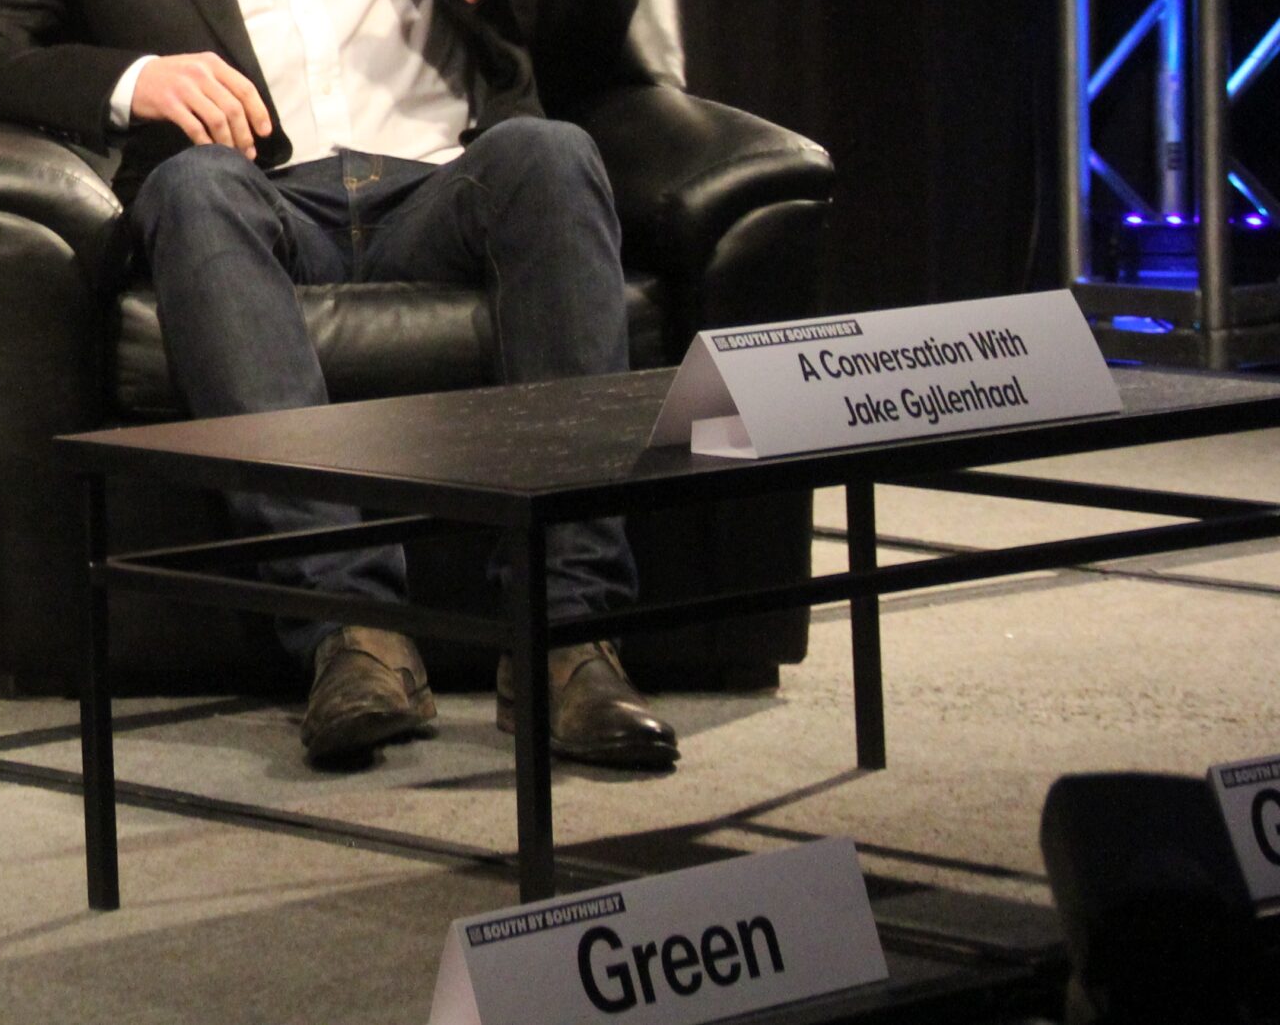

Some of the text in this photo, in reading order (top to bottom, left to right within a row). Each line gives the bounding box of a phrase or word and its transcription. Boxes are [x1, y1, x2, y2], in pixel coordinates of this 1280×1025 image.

[728, 332, 771, 349] SOUTH
[770, 329, 787, 343] BY
[786, 322, 858, 342] SOUTHWEST
[798, 328, 1028, 382] A Conversation With
[844, 375, 1029, 427] Jake Gyllenhaal
[482, 918, 527, 941] SOUTH
[528, 914, 545, 929] BY
[545, 895, 622, 925] SOUTHWEST
[577, 915, 785, 1014] Green
